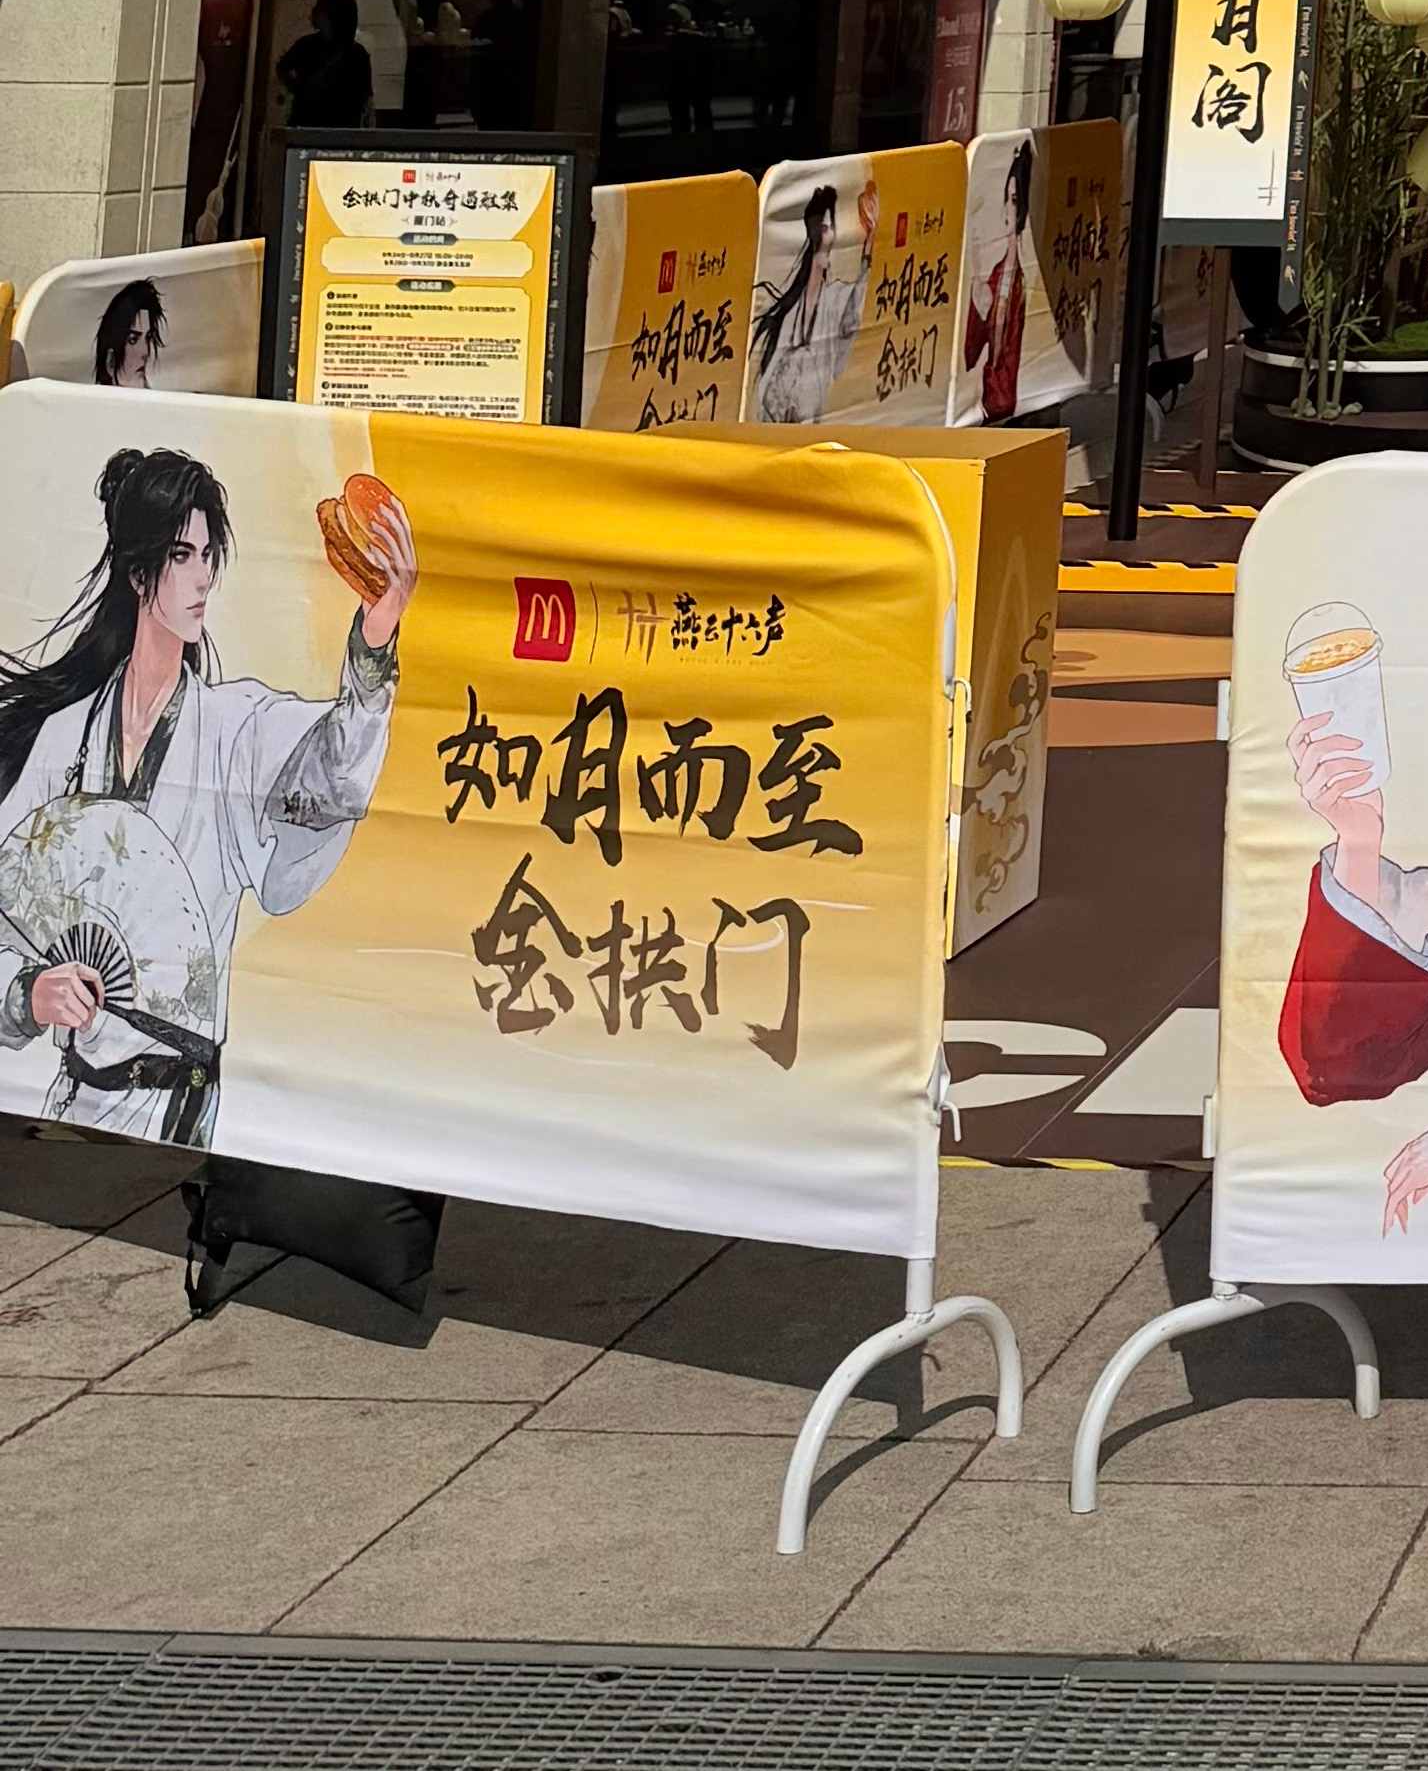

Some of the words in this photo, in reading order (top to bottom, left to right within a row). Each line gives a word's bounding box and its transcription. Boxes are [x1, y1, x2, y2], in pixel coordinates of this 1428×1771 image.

[875, 253, 950, 325] 如月而至
[631, 298, 734, 385] 如月而至
[876, 325, 938, 402] 金拱门
[670, 591, 786, 657] 燕云十六声
[437, 684, 864, 867] 如月而至
[471, 853, 811, 1071] 金拱门
